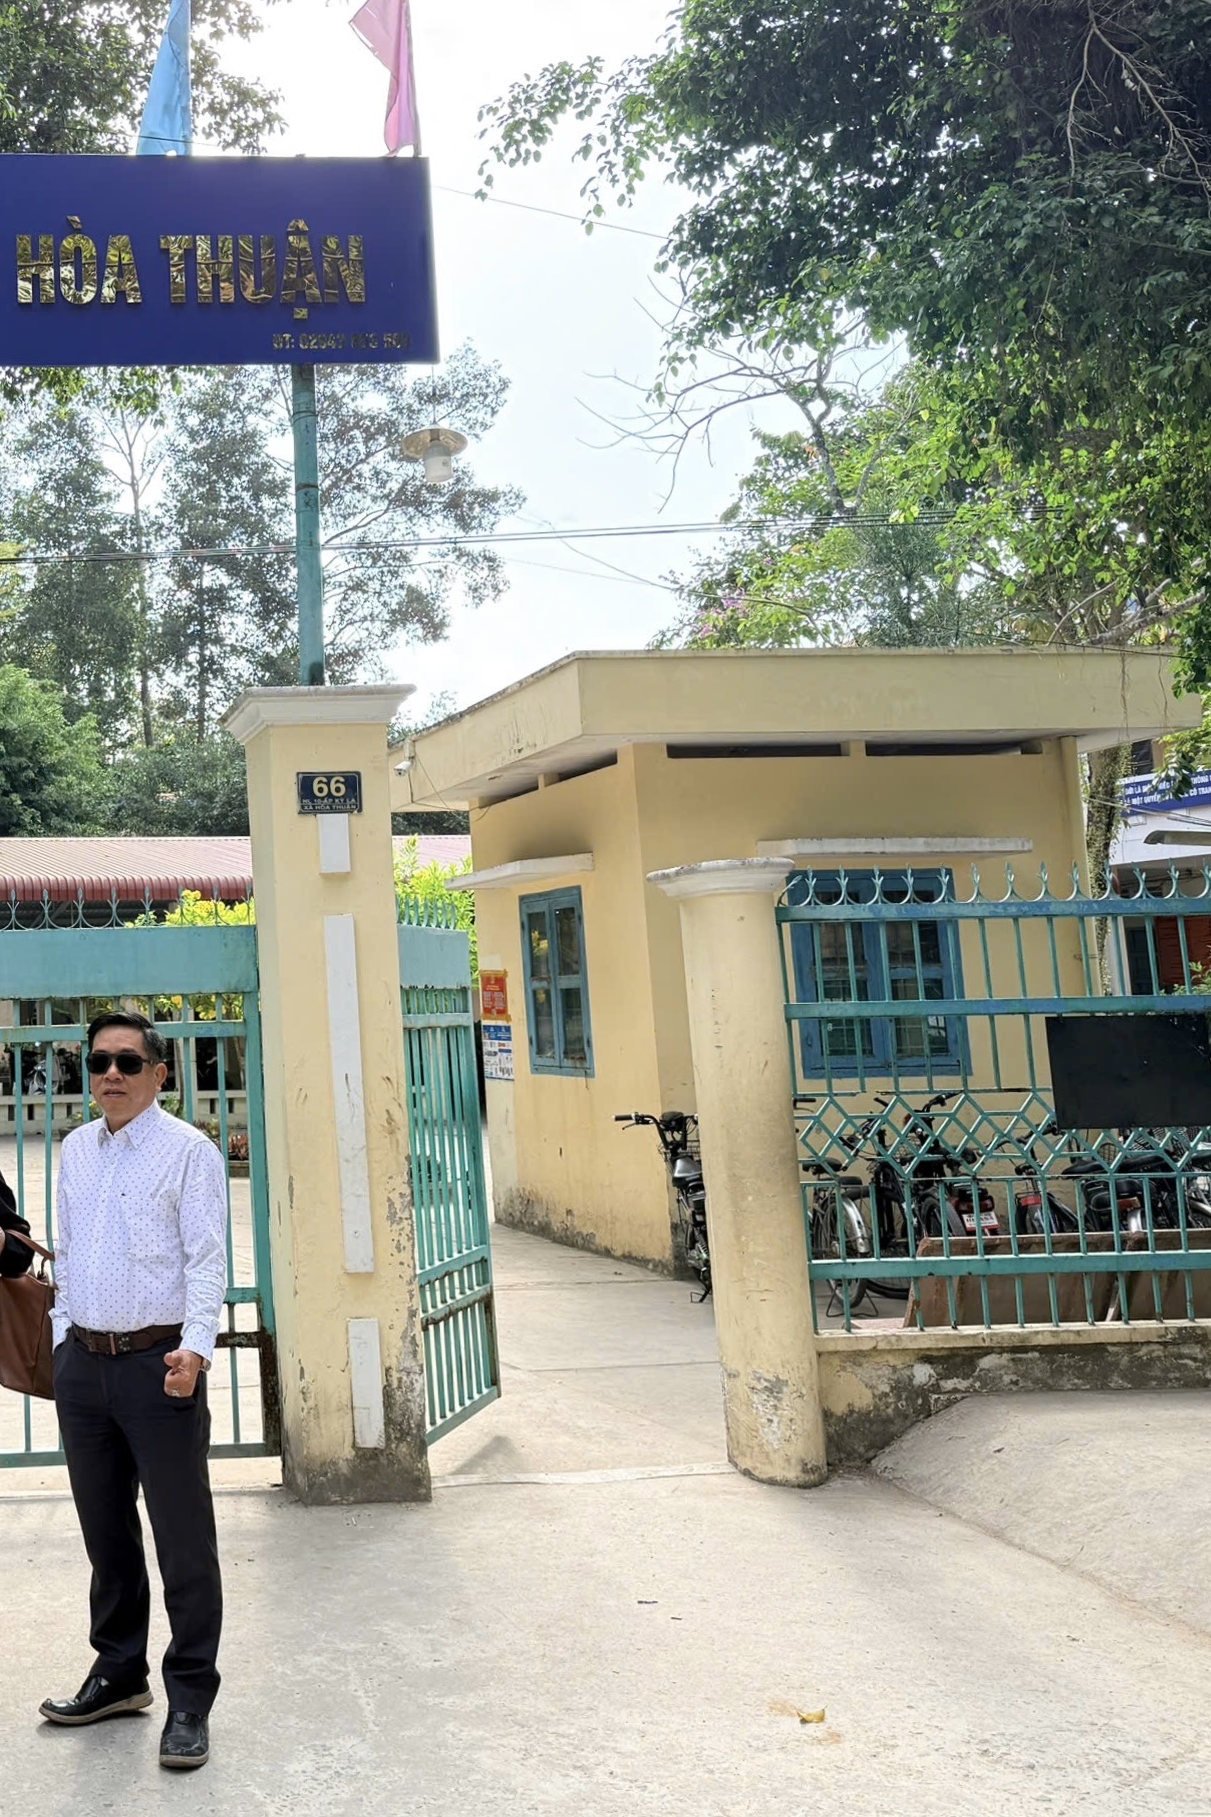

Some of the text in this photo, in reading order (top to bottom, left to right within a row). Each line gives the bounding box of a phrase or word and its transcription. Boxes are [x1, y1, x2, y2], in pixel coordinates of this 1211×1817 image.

[15, 215, 142, 305] HÒA
[159, 218, 367, 320] THUẬN
[313, 776, 346, 797] 66
